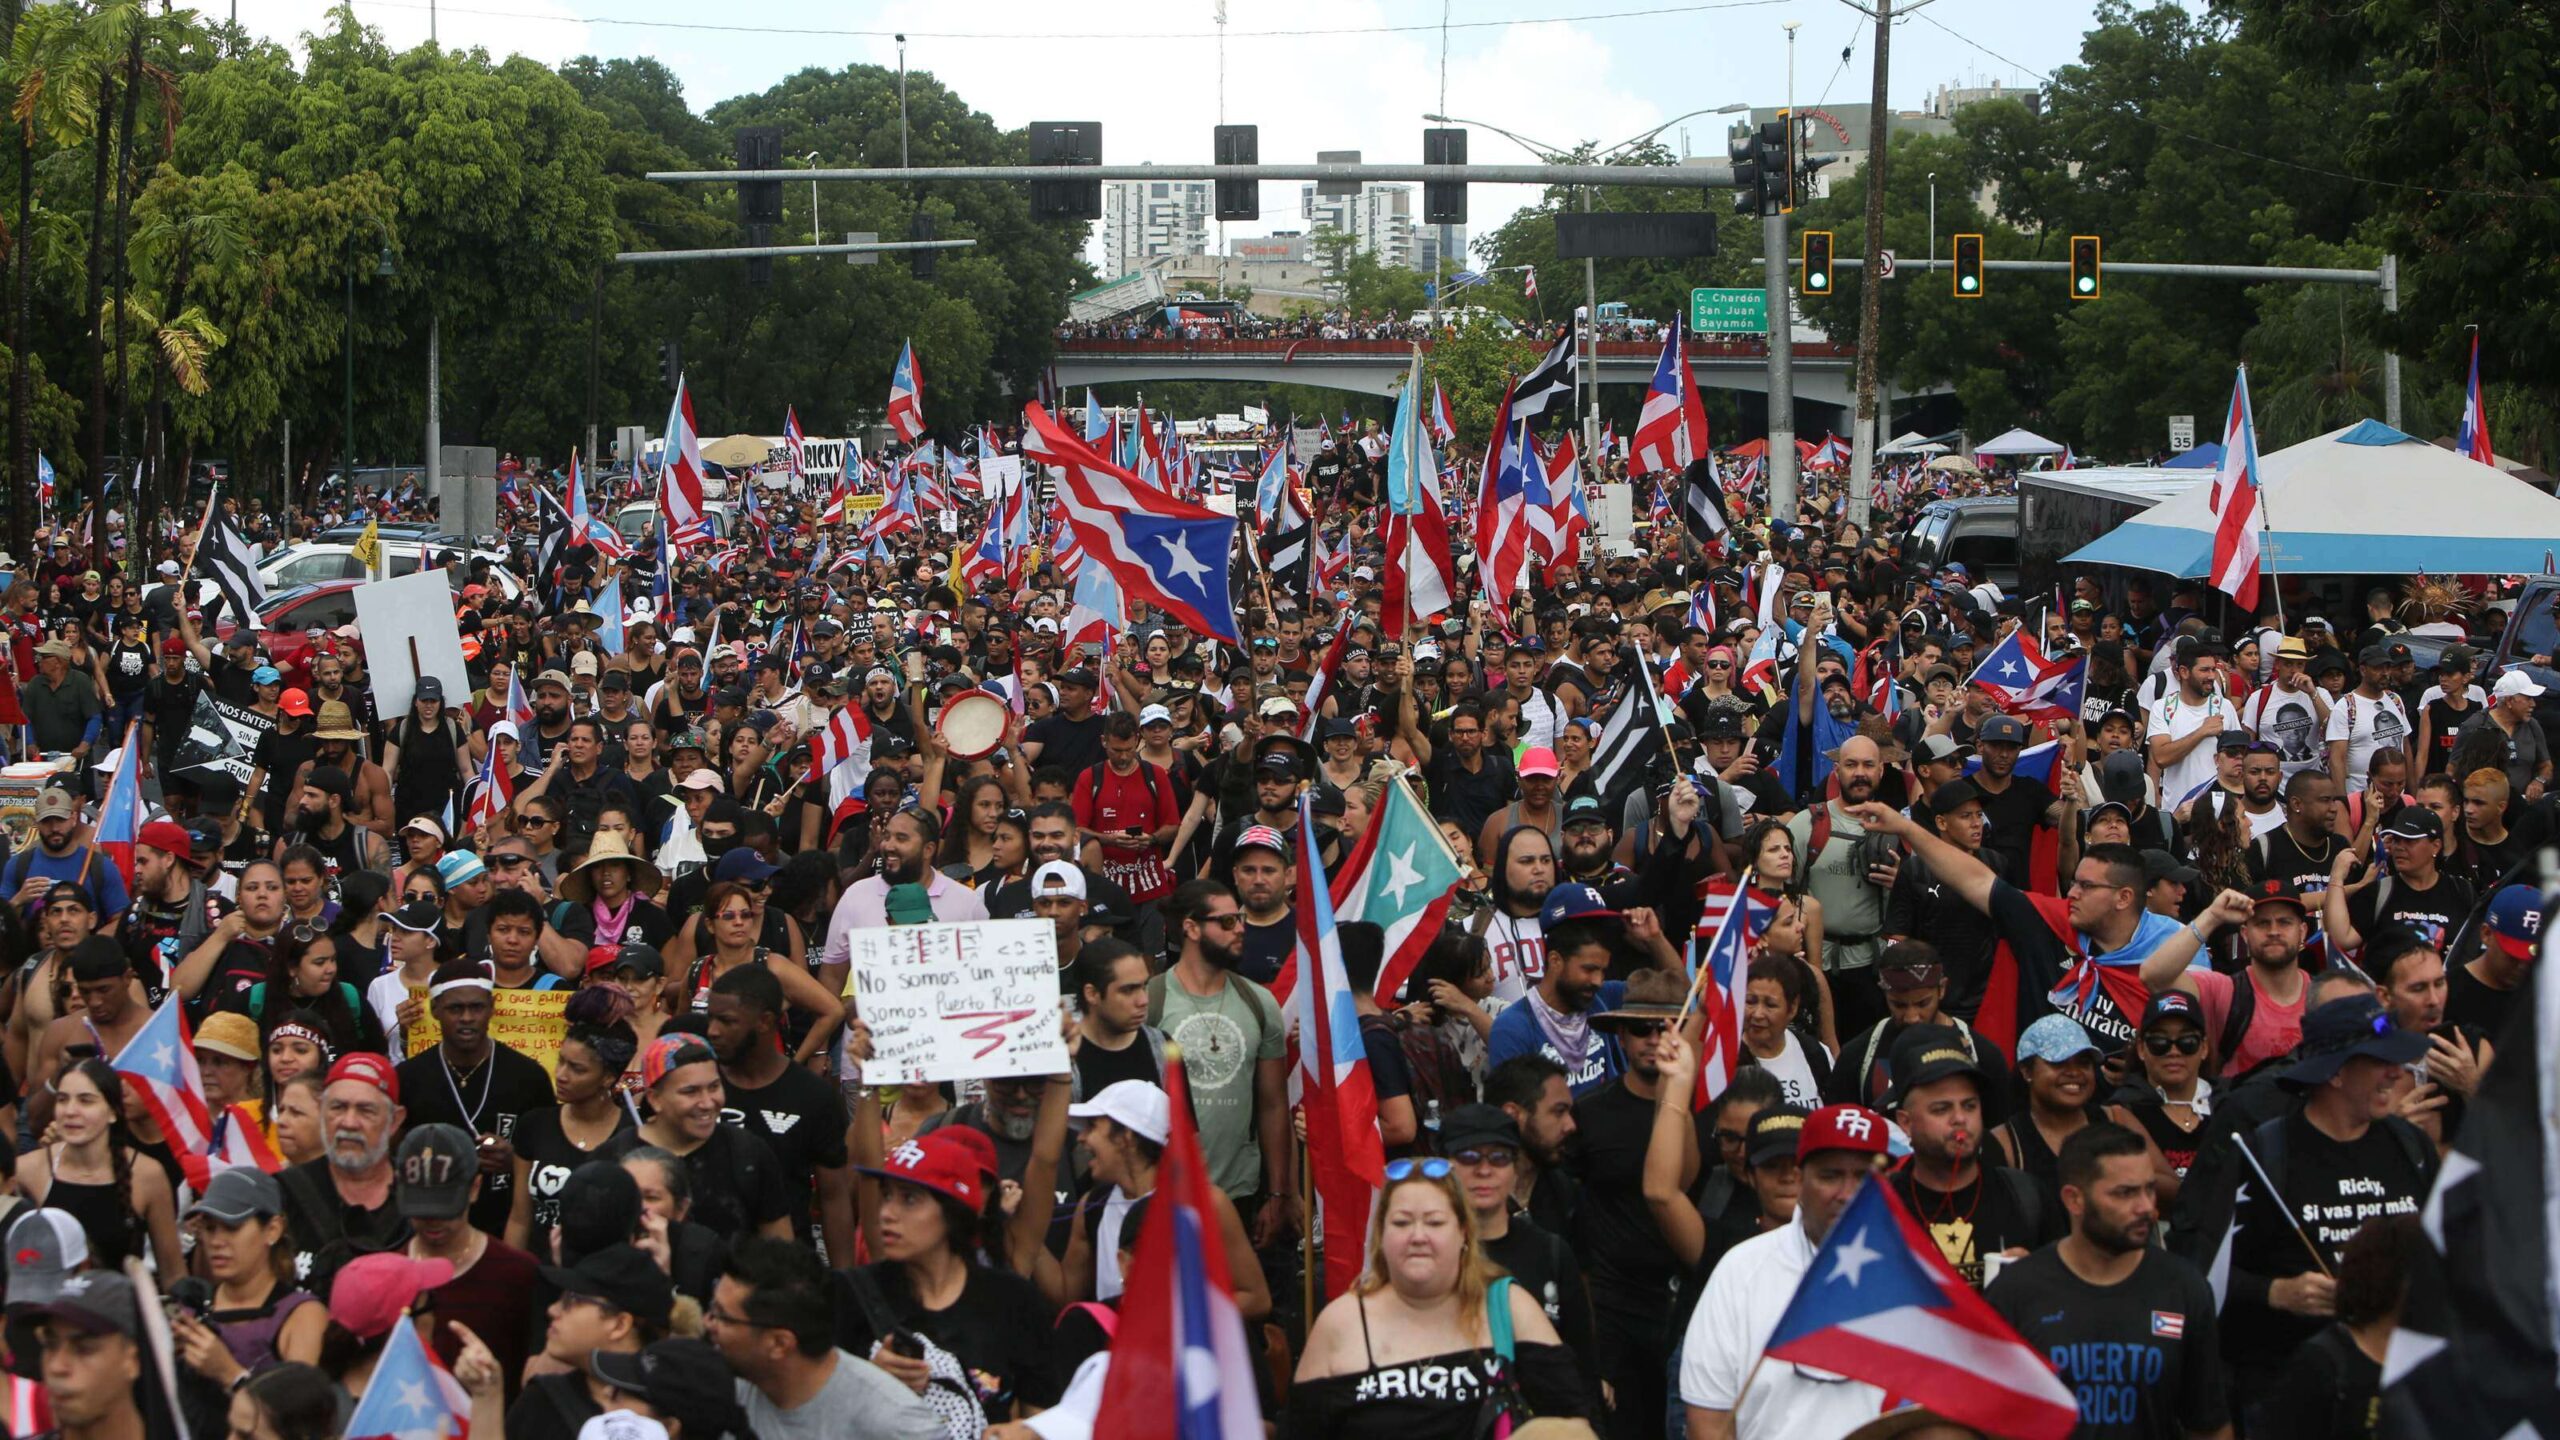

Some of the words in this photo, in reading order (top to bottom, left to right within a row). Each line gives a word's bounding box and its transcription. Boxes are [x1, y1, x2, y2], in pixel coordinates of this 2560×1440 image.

[1697, 293, 1706, 302] C.
[1712, 292, 1760, 302] Chardón
[1699, 306, 1720, 315] San
[1726, 306, 1754, 315] Juan
[1700, 318, 1754, 329] Bayamón
[2174, 437, 2191, 448] 35
[804, 444, 842, 468] RICKY
[238, 731, 251, 742] SIN
[224, 762, 251, 781] SEMI
[858, 970, 886, 994] No
[936, 991, 985, 1014] Puerto
[992, 986, 1036, 1010] Rico
[2338, 1177, 2386, 1196] Ricky,
[2323, 1204, 2352, 1220] vas
[2356, 1202, 2382, 1220] por
[2050, 1342, 2163, 1385] PUERTO
[2075, 1384, 2138, 1424] RICO
